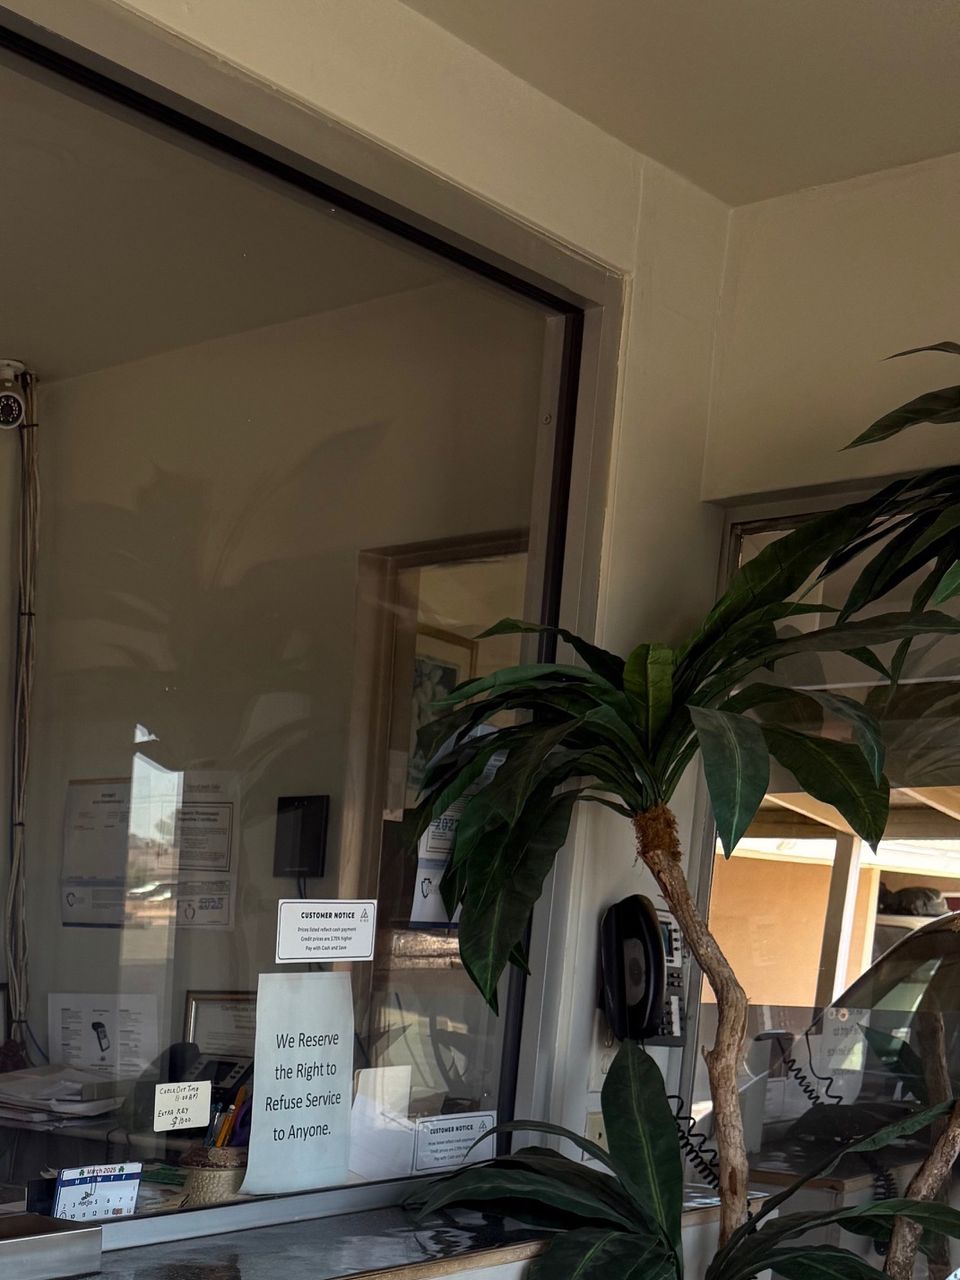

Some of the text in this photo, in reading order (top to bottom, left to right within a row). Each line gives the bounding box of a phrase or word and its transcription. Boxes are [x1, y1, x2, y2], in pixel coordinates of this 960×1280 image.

[300, 911, 355, 919] CUSTOMER NOTICE
[276, 1032, 339, 1049] We Reserve
[275, 1061, 337, 1081] the Right to
[265, 1091, 341, 1112] Refuse Service
[273, 1124, 331, 1141] to Anyone.
[430, 1124, 473, 1135] CUSTOMER NOTICE
